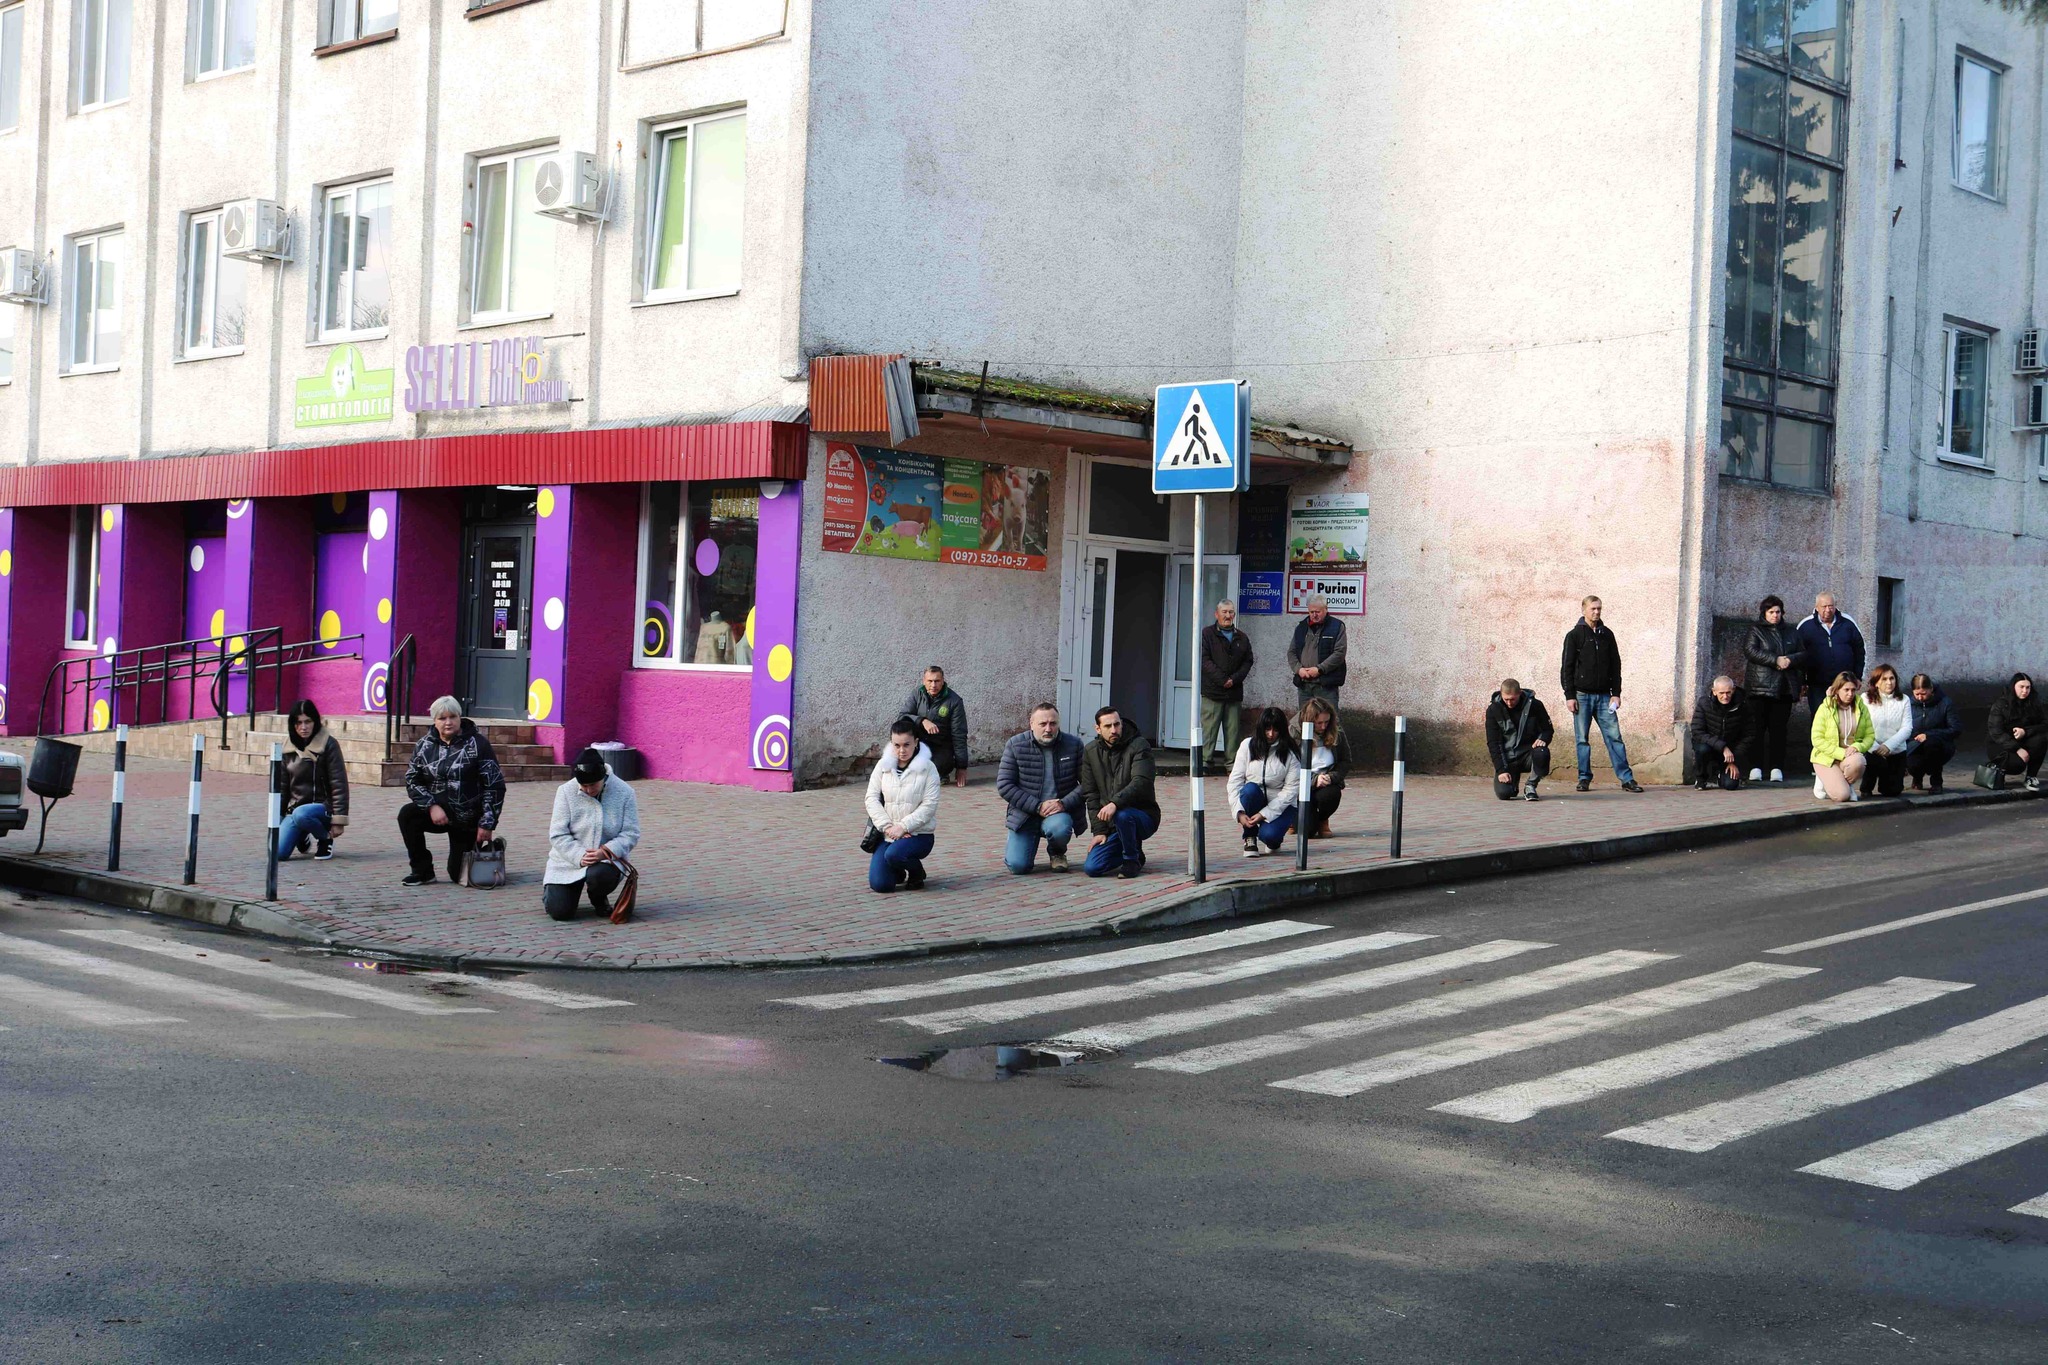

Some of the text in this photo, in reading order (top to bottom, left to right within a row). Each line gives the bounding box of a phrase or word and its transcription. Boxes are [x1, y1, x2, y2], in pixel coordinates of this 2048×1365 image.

[405, 342, 480, 413] SELLI
[490, 337, 523, 406] ВСЕ
[525, 380, 563, 404] ЛЮБИШ
[296, 397, 391, 422] СТОМАТОЛОГІЯ
[895, 466, 935, 477] КОНЦЕНТРАТИ
[826, 494, 855, 504] maxcare
[950, 550, 1029, 567] (097) 520-10-57
[1239, 588, 1281, 597] ВЕТЕРИНАРНА
[1317, 582, 1356, 594] Purina
[1326, 597, 1357, 606] рокорм
